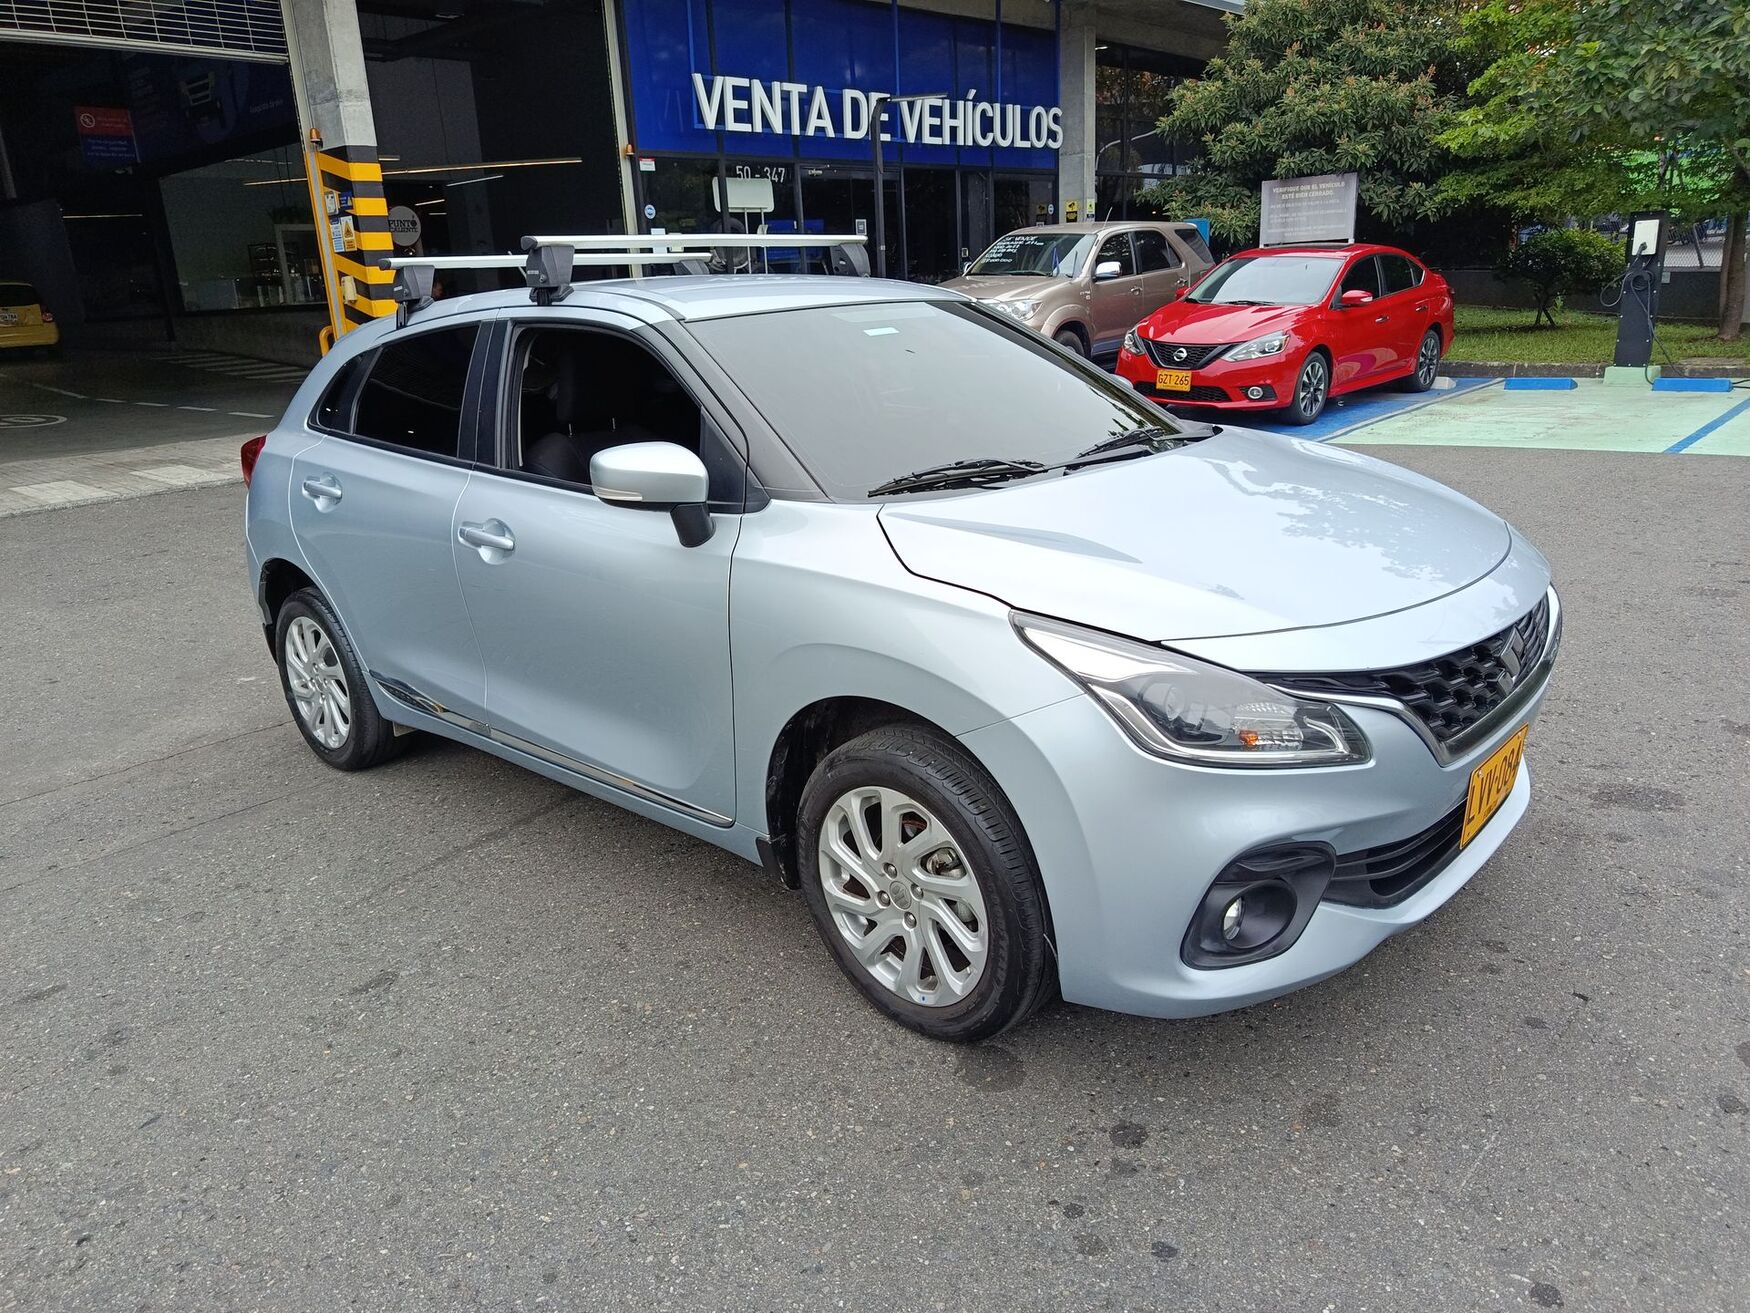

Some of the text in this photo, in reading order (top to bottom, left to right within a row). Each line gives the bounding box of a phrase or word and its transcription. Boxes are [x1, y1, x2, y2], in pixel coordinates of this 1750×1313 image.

[691, 73, 1064, 150] VENTA DE VEHÍCULOS
[1158, 373, 1190, 386] GZT 265
